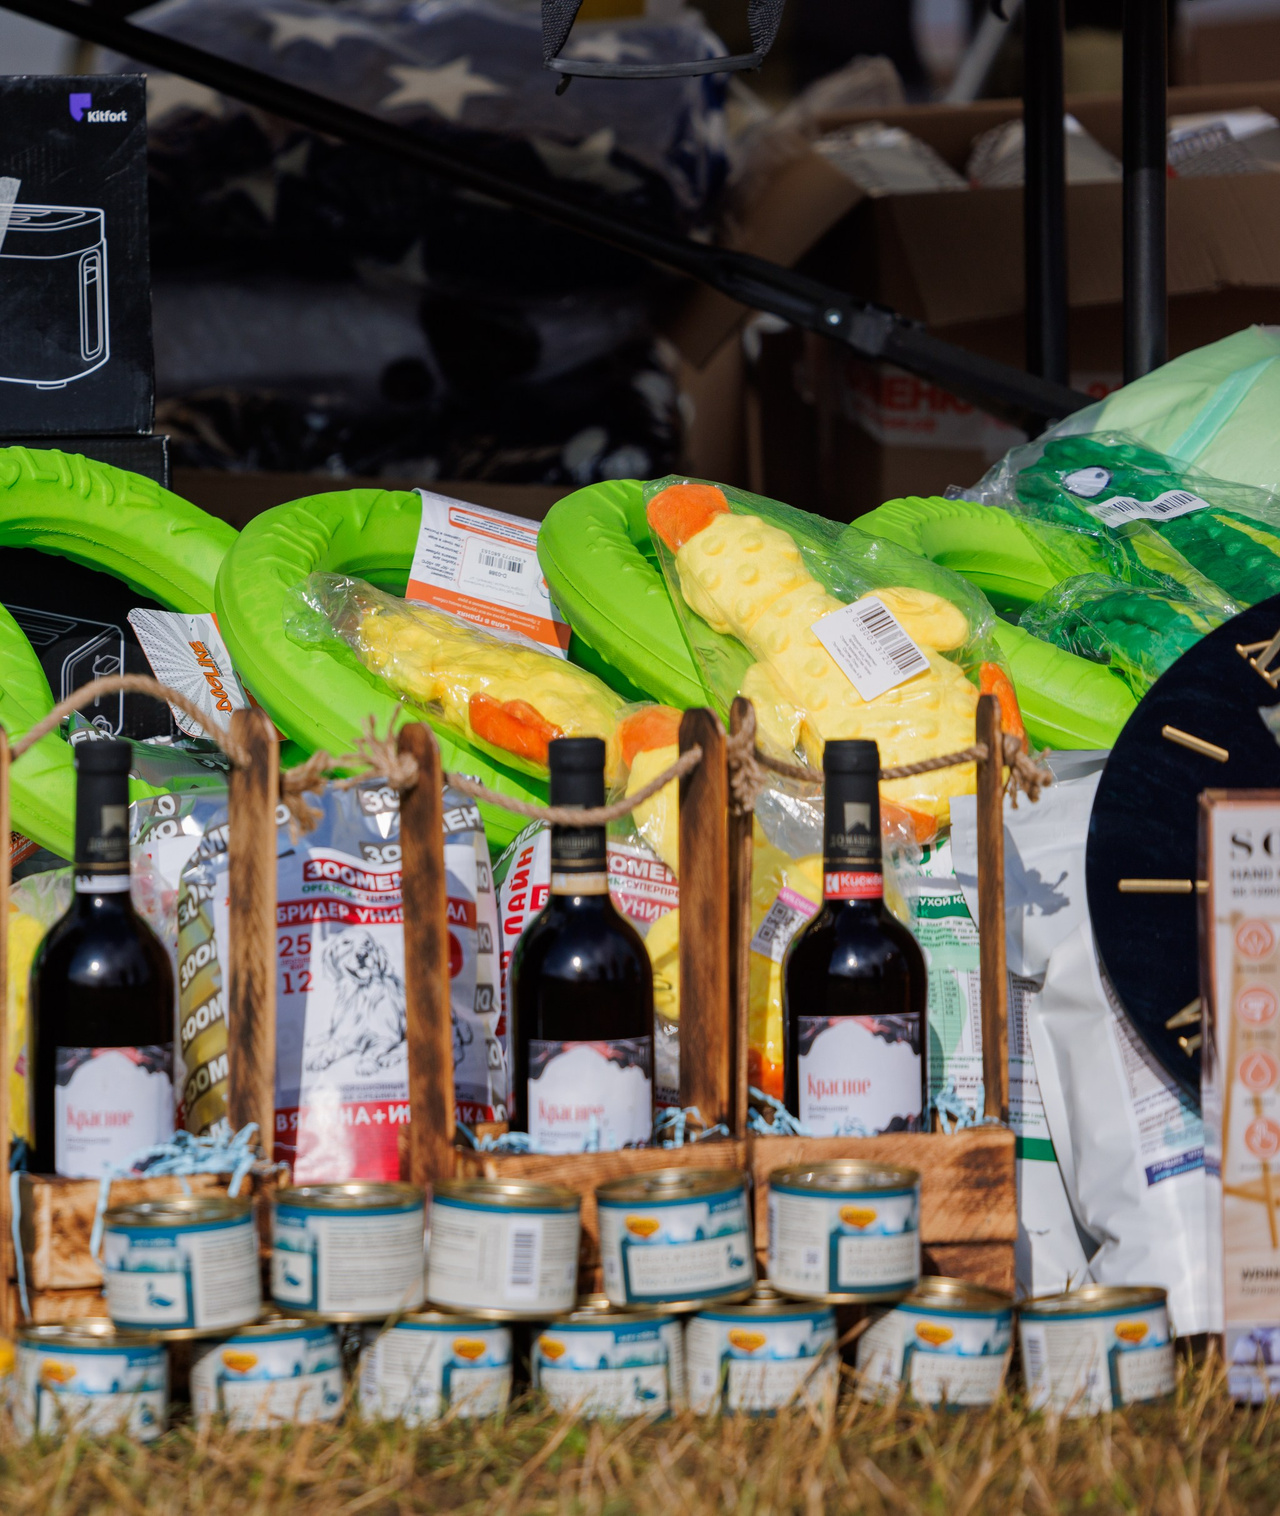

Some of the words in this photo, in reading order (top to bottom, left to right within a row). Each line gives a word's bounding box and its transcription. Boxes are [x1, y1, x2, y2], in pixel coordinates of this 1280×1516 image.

[87, 108, 128, 123] Kitfort
[278, 934, 312, 958] 25
[282, 970, 314, 995] 12
